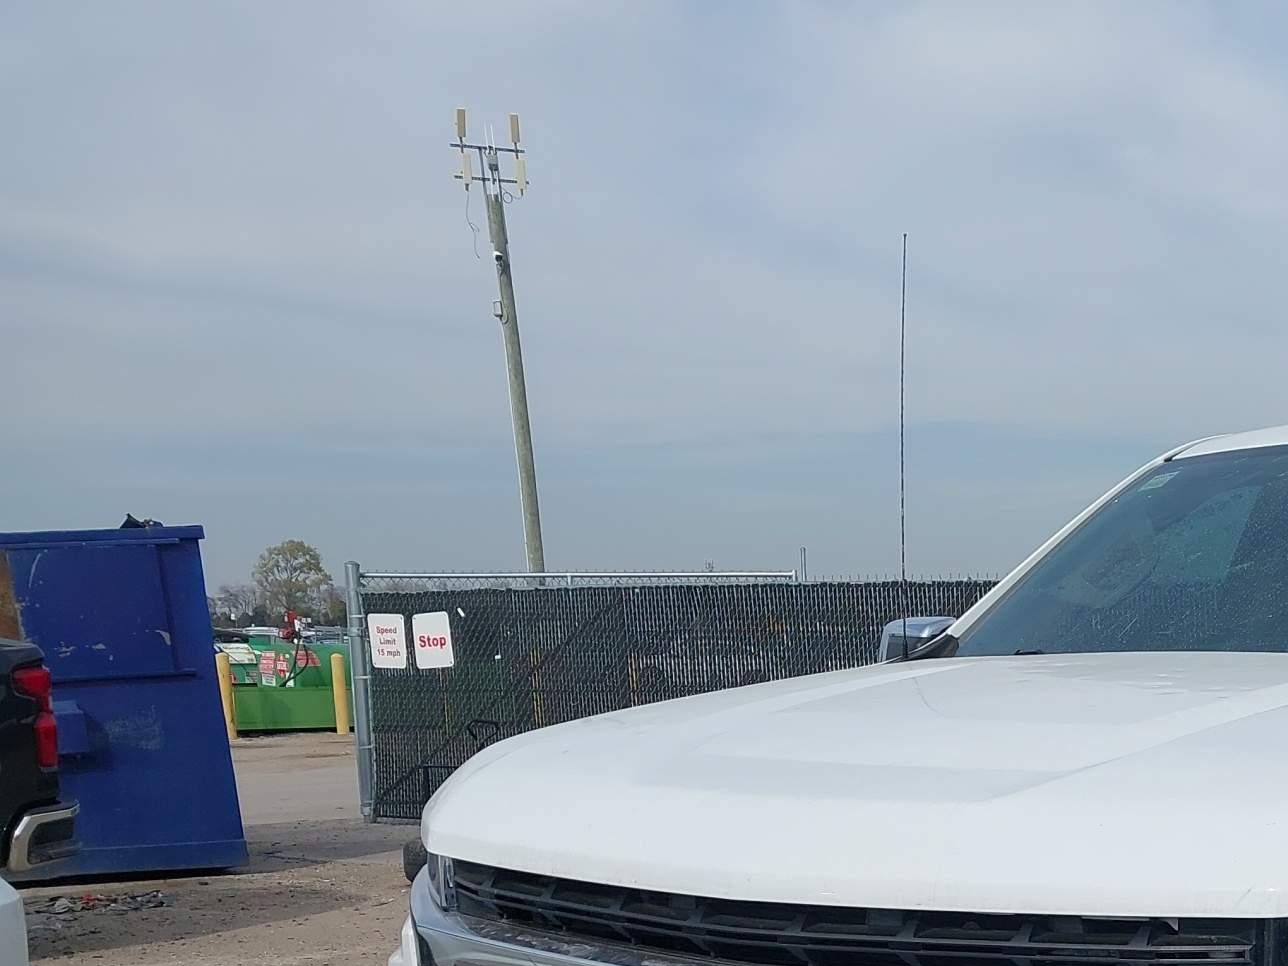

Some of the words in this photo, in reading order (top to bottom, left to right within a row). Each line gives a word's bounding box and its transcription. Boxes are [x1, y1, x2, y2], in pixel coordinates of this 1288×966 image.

[376, 626, 397, 635] Speed
[379, 638, 396, 646] Limit
[418, 635, 447, 649] Stop
[386, 650, 401, 658] mph
